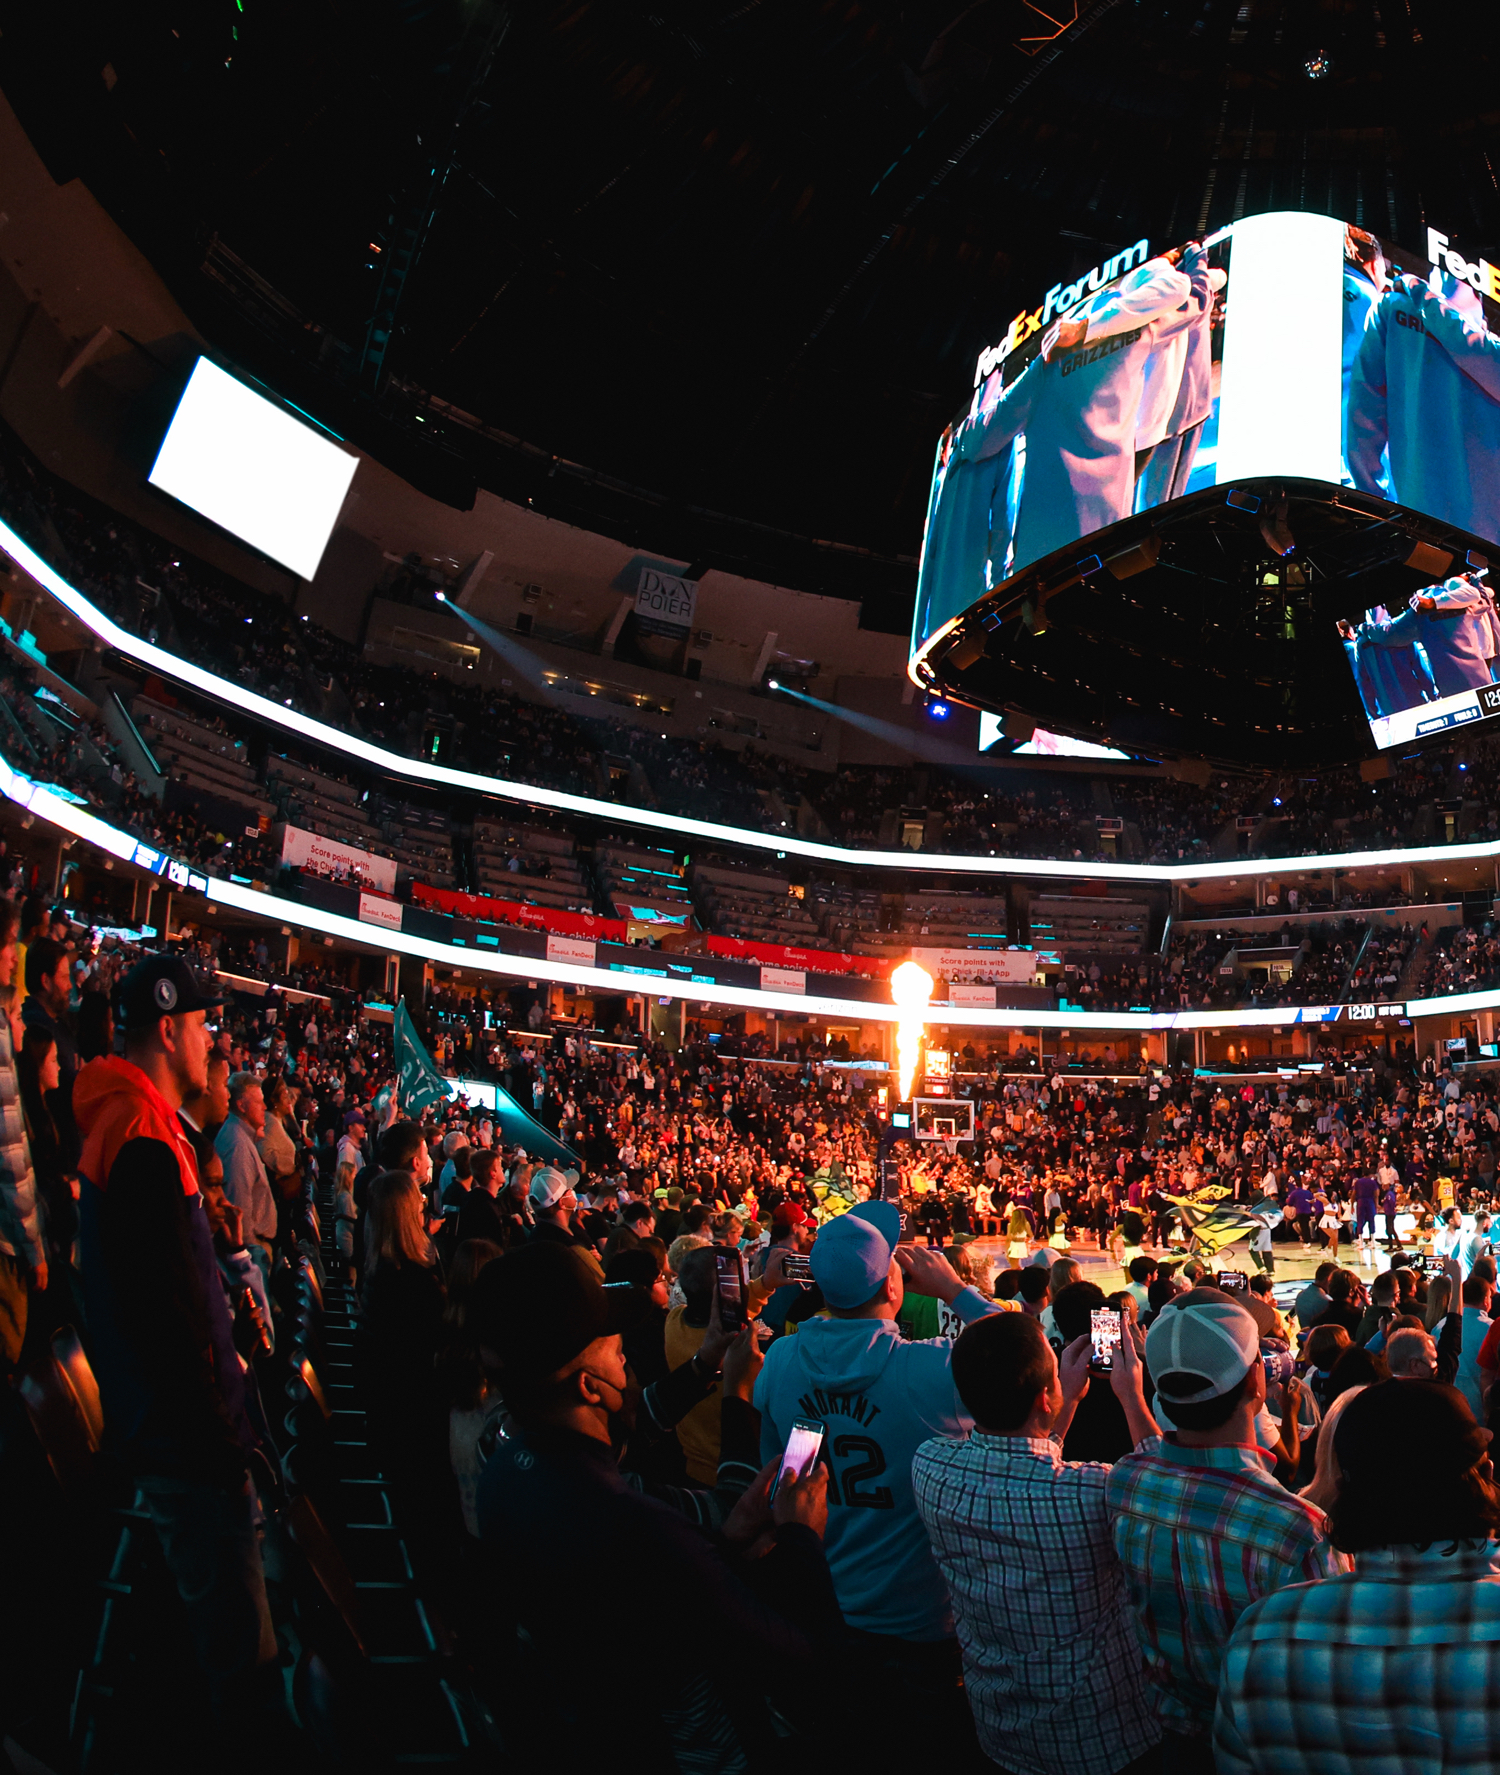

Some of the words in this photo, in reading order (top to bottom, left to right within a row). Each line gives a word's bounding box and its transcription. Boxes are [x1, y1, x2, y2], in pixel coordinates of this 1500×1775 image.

[973, 239, 1148, 388] FedExForum
[639, 590, 691, 617] POIER
[310, 844, 331, 858] Score
[332, 852, 353, 866] points
[354, 860, 370, 871] with
[937, 967, 950, 975] the
[952, 968, 994, 976] Chick-fil-A
[995, 970, 1010, 978] App
[940, 957, 962, 965] Score
[963, 958, 987, 967] points
[989, 959, 1005, 967] with
[1348, 1005, 1375, 1020] 12:00
[942, 1311, 961, 1338] 23
[798, 1388, 881, 1428] MORANT
